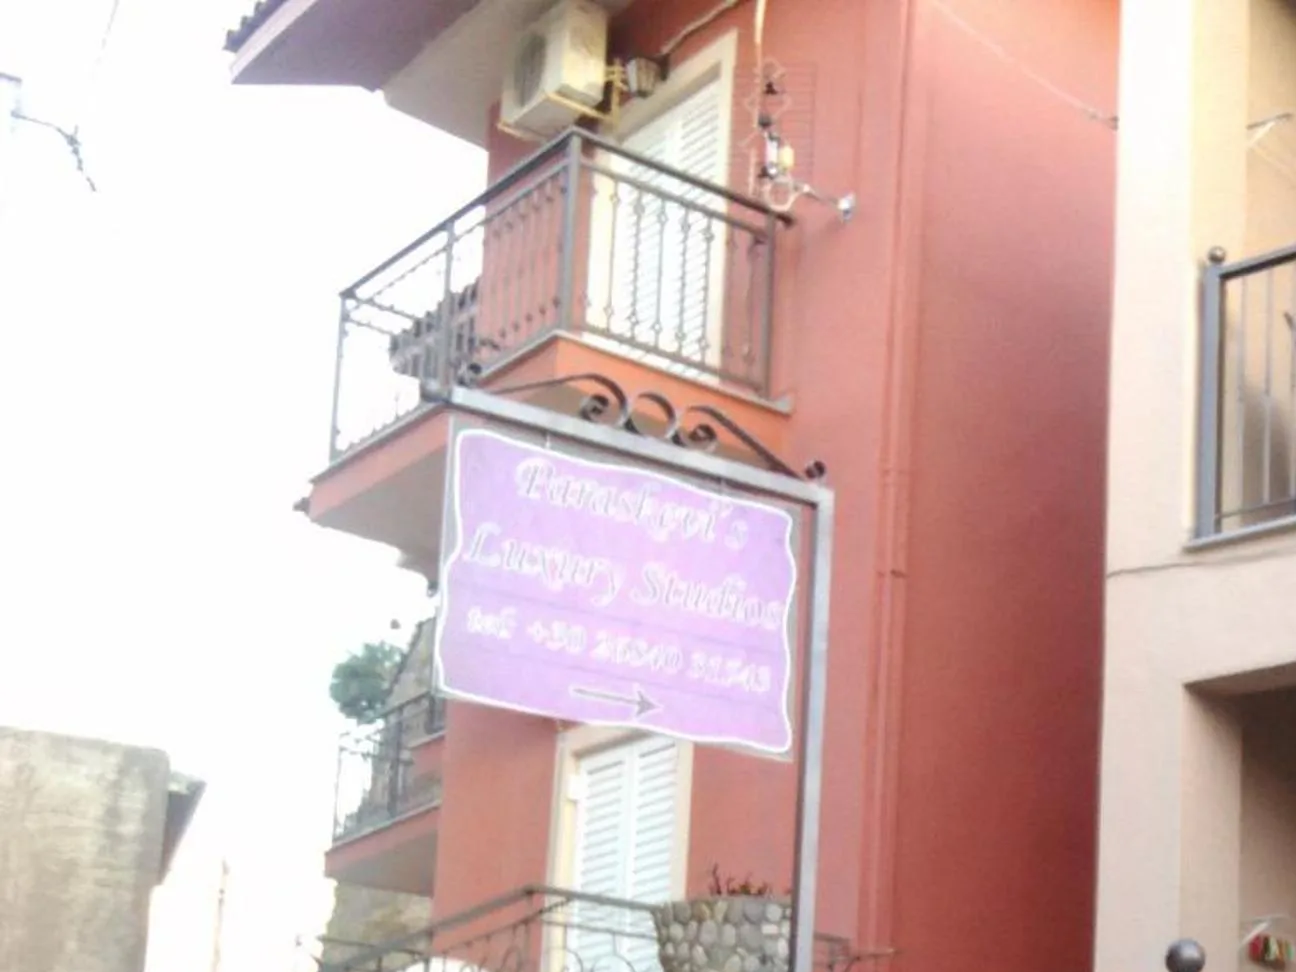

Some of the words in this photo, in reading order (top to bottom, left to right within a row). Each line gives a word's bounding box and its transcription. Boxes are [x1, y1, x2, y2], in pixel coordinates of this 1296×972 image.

[463, 522, 626, 606] Luxury
[630, 561, 784, 630] Studios
[526, 620, 587, 654] +30
